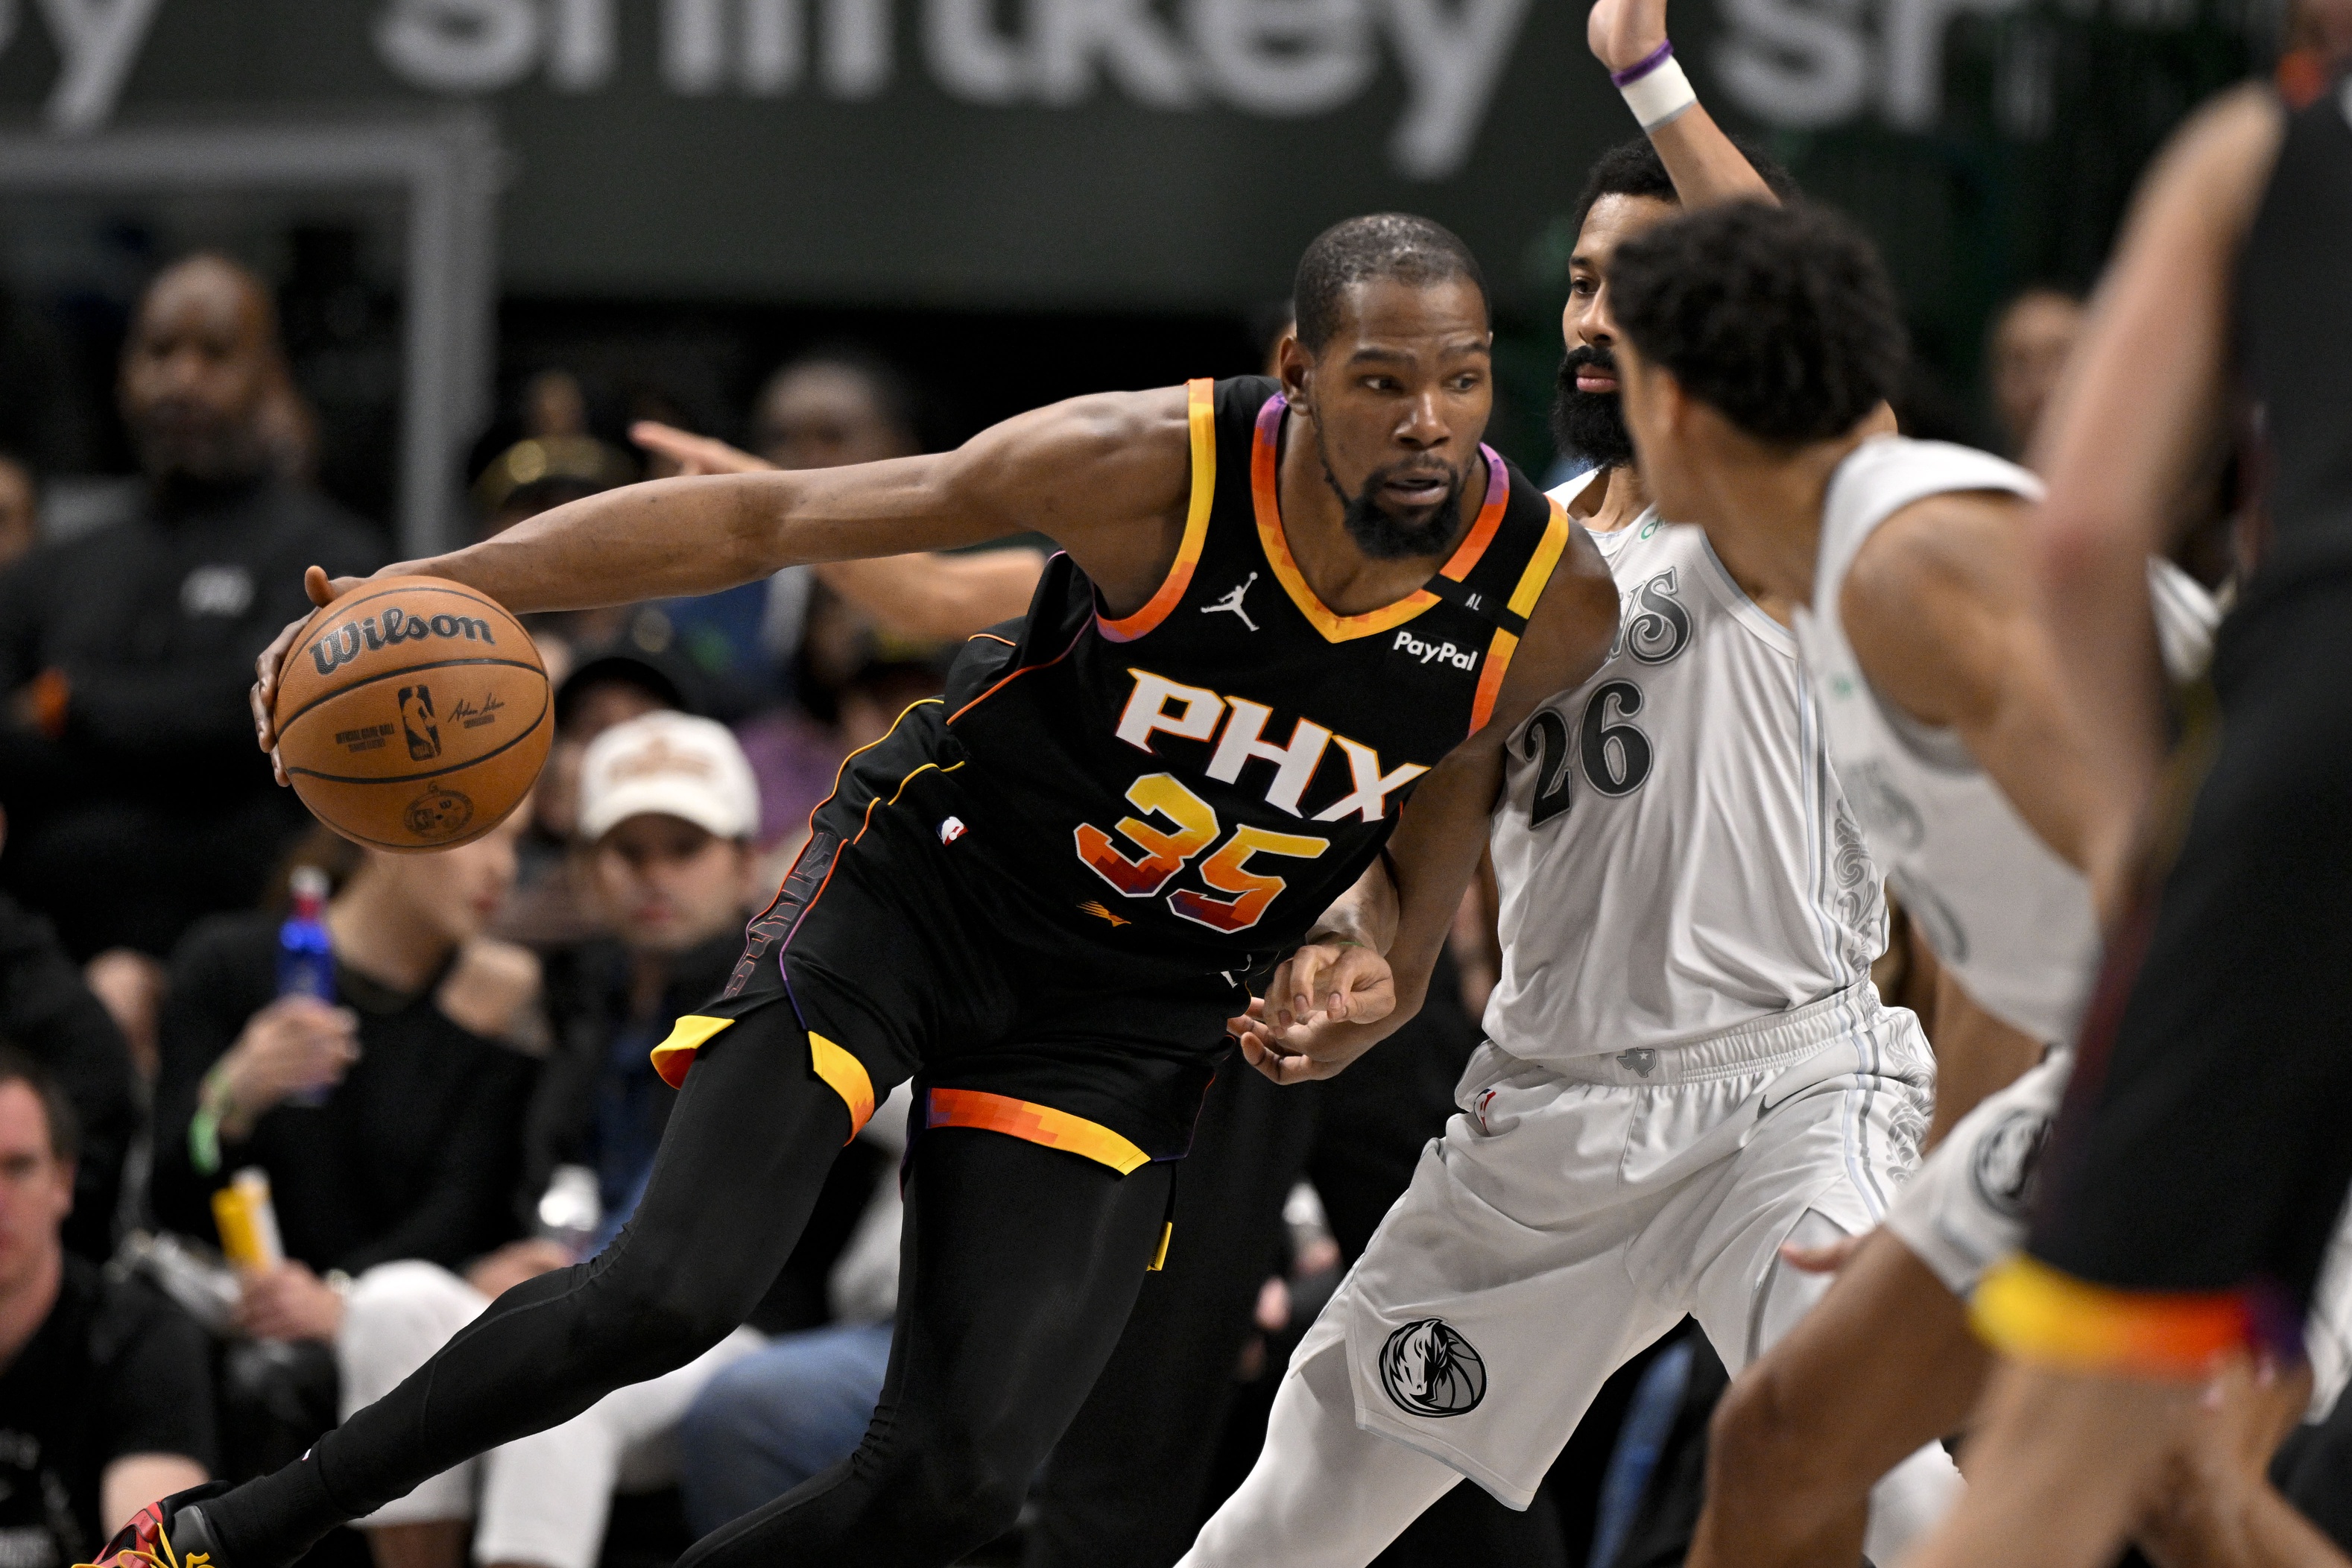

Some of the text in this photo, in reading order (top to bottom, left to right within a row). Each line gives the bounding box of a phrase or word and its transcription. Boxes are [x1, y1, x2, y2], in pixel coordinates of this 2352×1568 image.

[309, 608, 496, 676] Wilson
[1392, 630, 1479, 671] PayPal
[1464, 592, 1482, 611] AL
[1116, 668, 1432, 822] PHX
[1523, 677, 1654, 829] 26
[1073, 772, 1330, 934] 35
